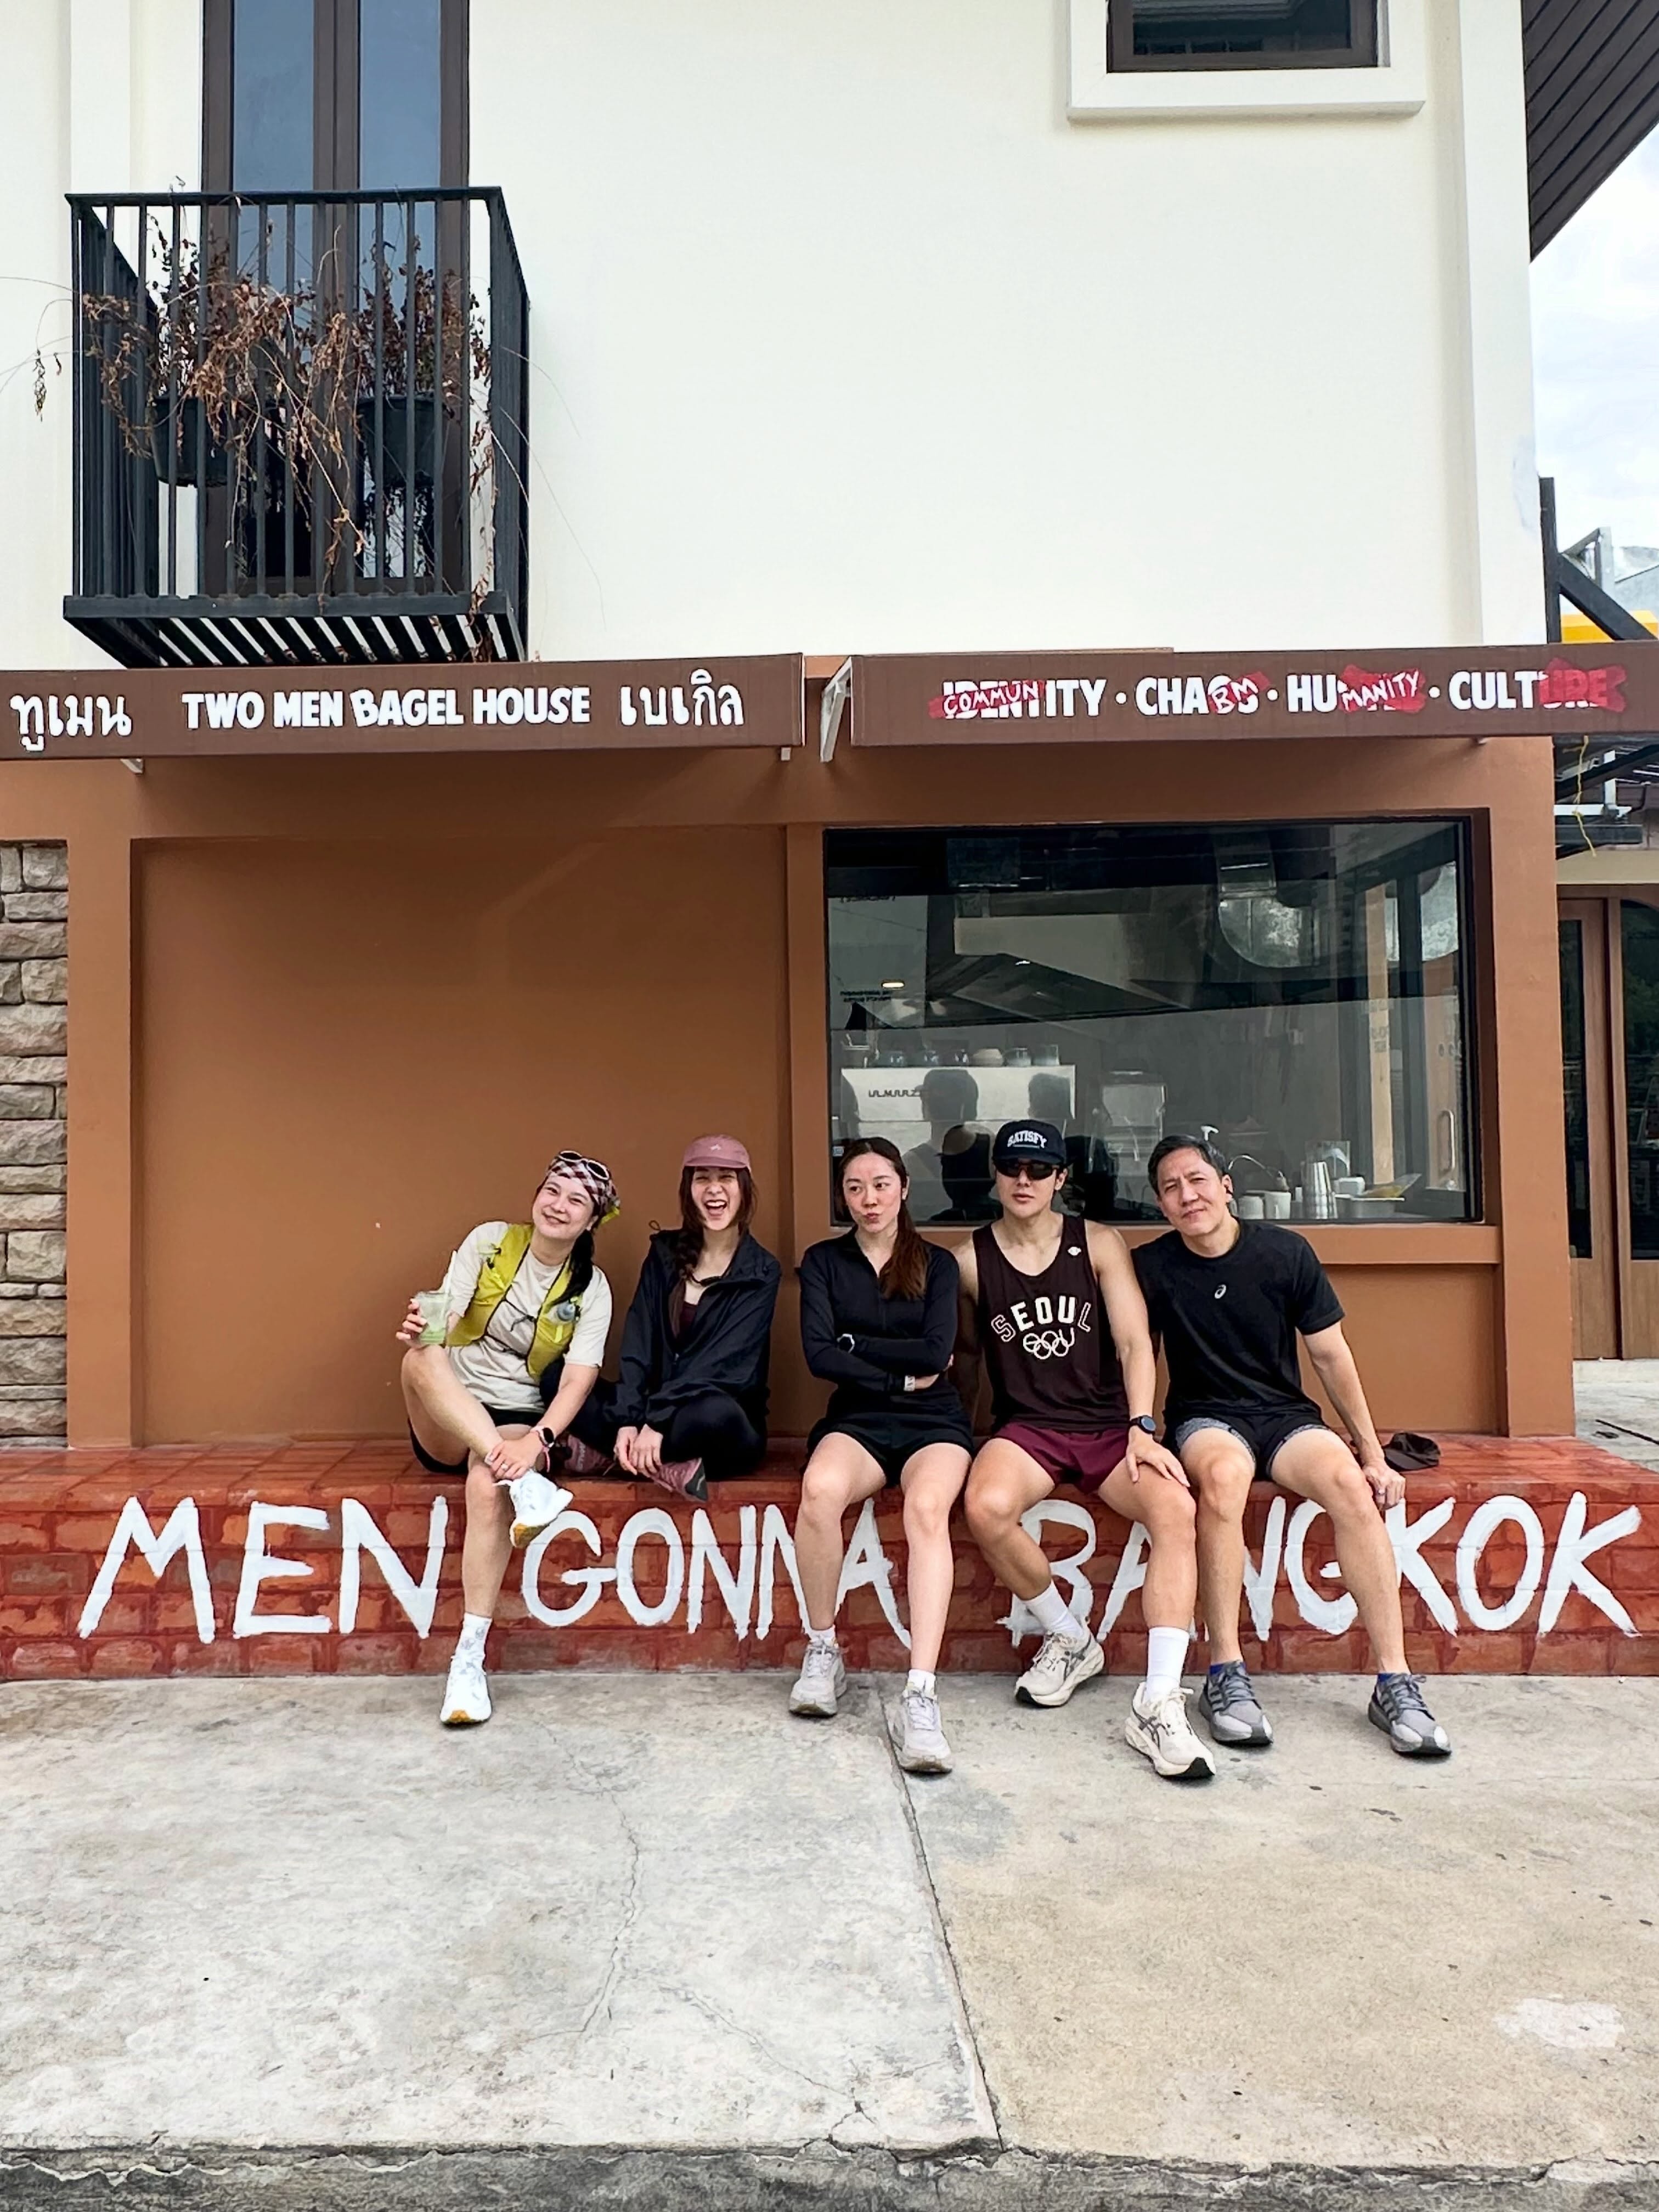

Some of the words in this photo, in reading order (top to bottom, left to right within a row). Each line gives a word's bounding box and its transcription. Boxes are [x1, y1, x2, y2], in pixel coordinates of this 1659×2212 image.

[182, 691, 264, 730] TWO
[274, 691, 343, 727] MEN
[351, 688, 465, 727] BAGEL
[473, 686, 590, 725] HOUSE
[620, 668, 745, 726] เบเกิล
[9, 695, 133, 752] ทูเมน
[1007, 1130, 1047, 1148] SATISFY
[991, 1295, 1091, 1342] SEOUL
[77, 1496, 448, 1644] MEN
